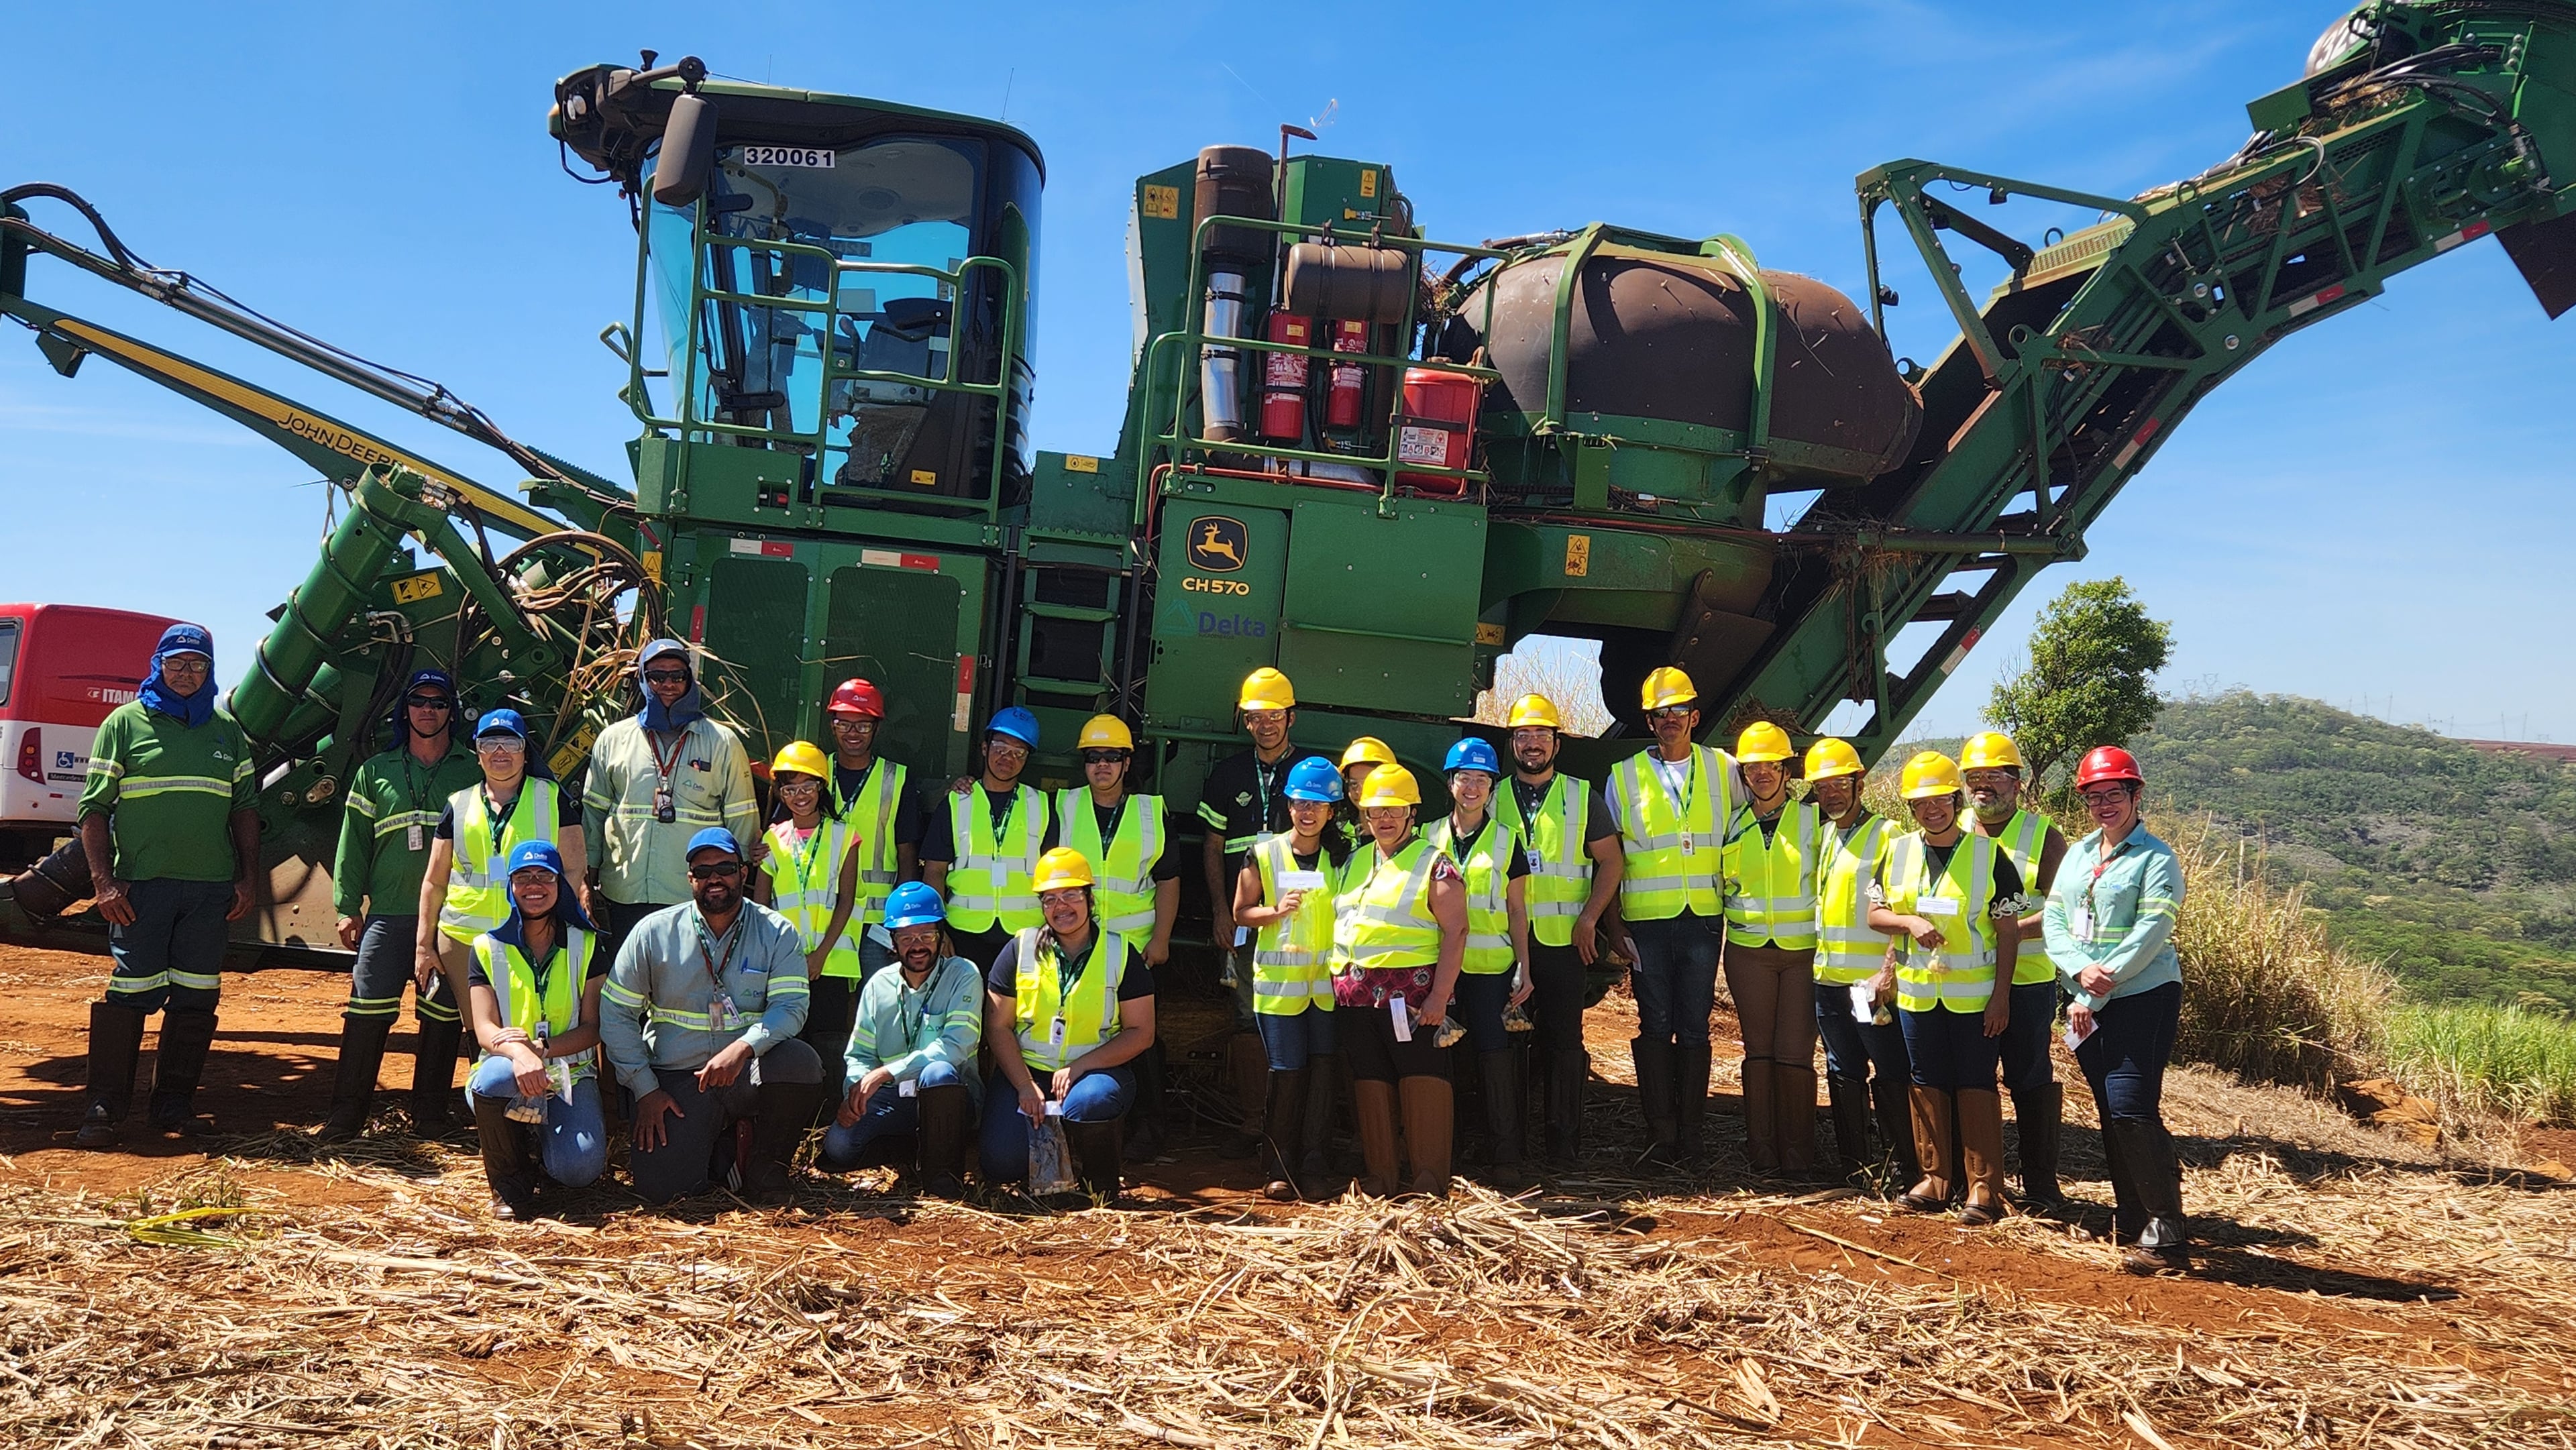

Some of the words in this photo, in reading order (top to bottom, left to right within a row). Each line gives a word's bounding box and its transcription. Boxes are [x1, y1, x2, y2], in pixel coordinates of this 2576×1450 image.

[746, 148, 831, 166] 320061
[278, 412, 335, 444] JOHN
[1181, 577, 1250, 596] CH570
[1198, 611, 1266, 637] Delta
